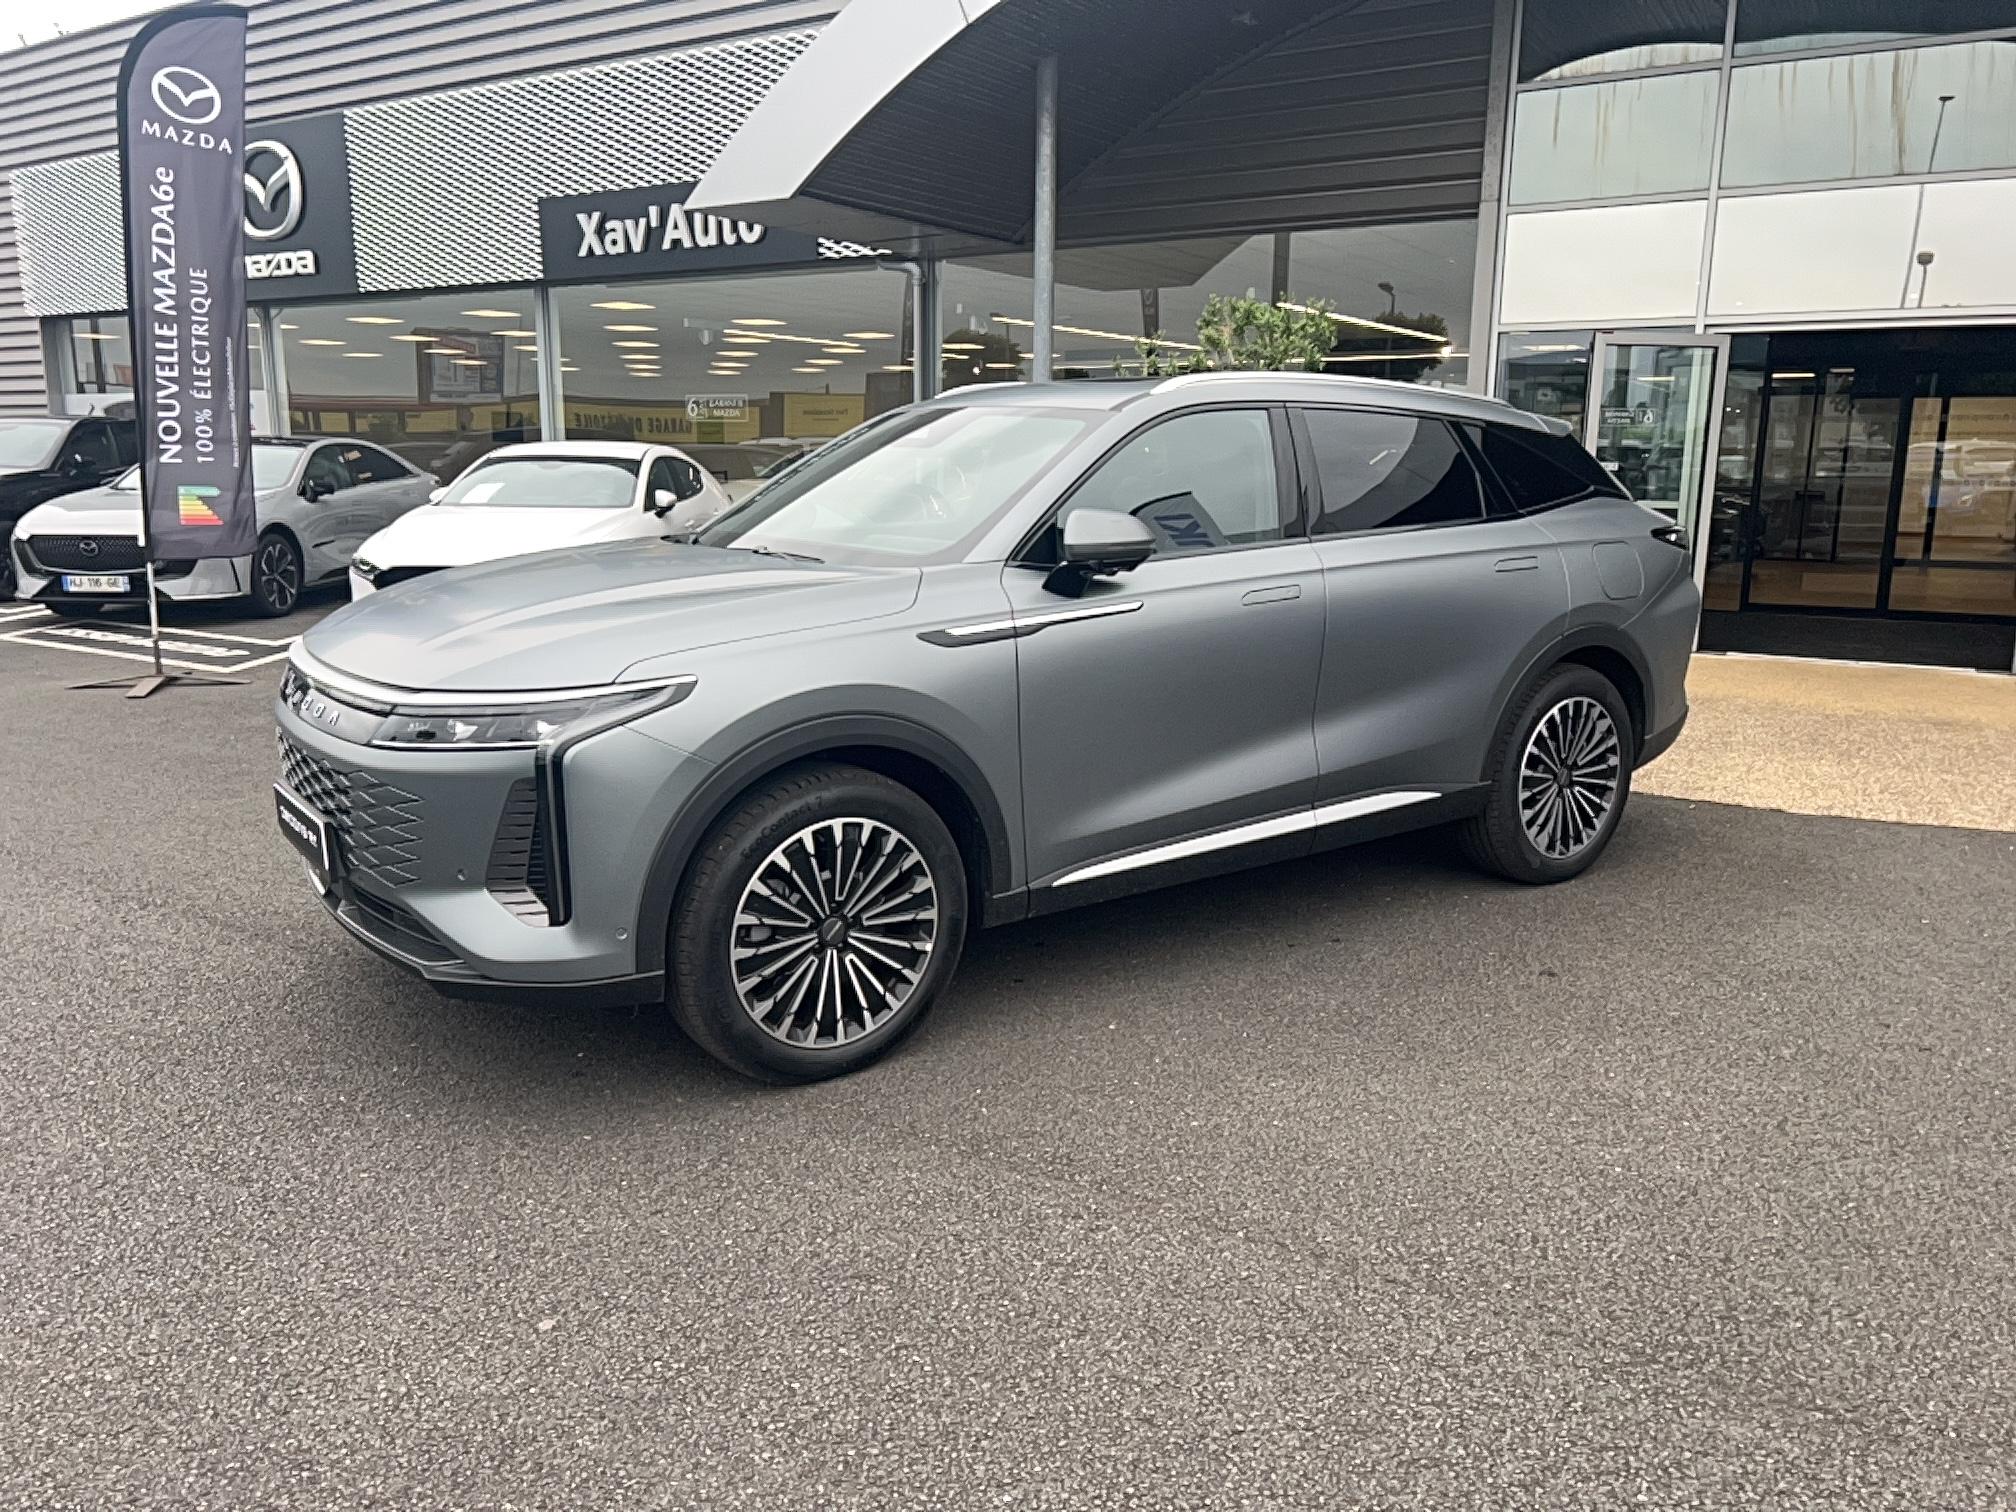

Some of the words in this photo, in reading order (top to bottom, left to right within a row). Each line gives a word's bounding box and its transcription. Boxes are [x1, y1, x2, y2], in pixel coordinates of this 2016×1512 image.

[141, 119, 232, 154] MAZDA
[150, 166, 178, 316] MAZDA6e
[244, 250, 316, 279] azda
[189, 267, 213, 400] ÉLECTRIQUE
[154, 321, 183, 464] NOUVELLE
[194, 408, 215, 463] 100%
